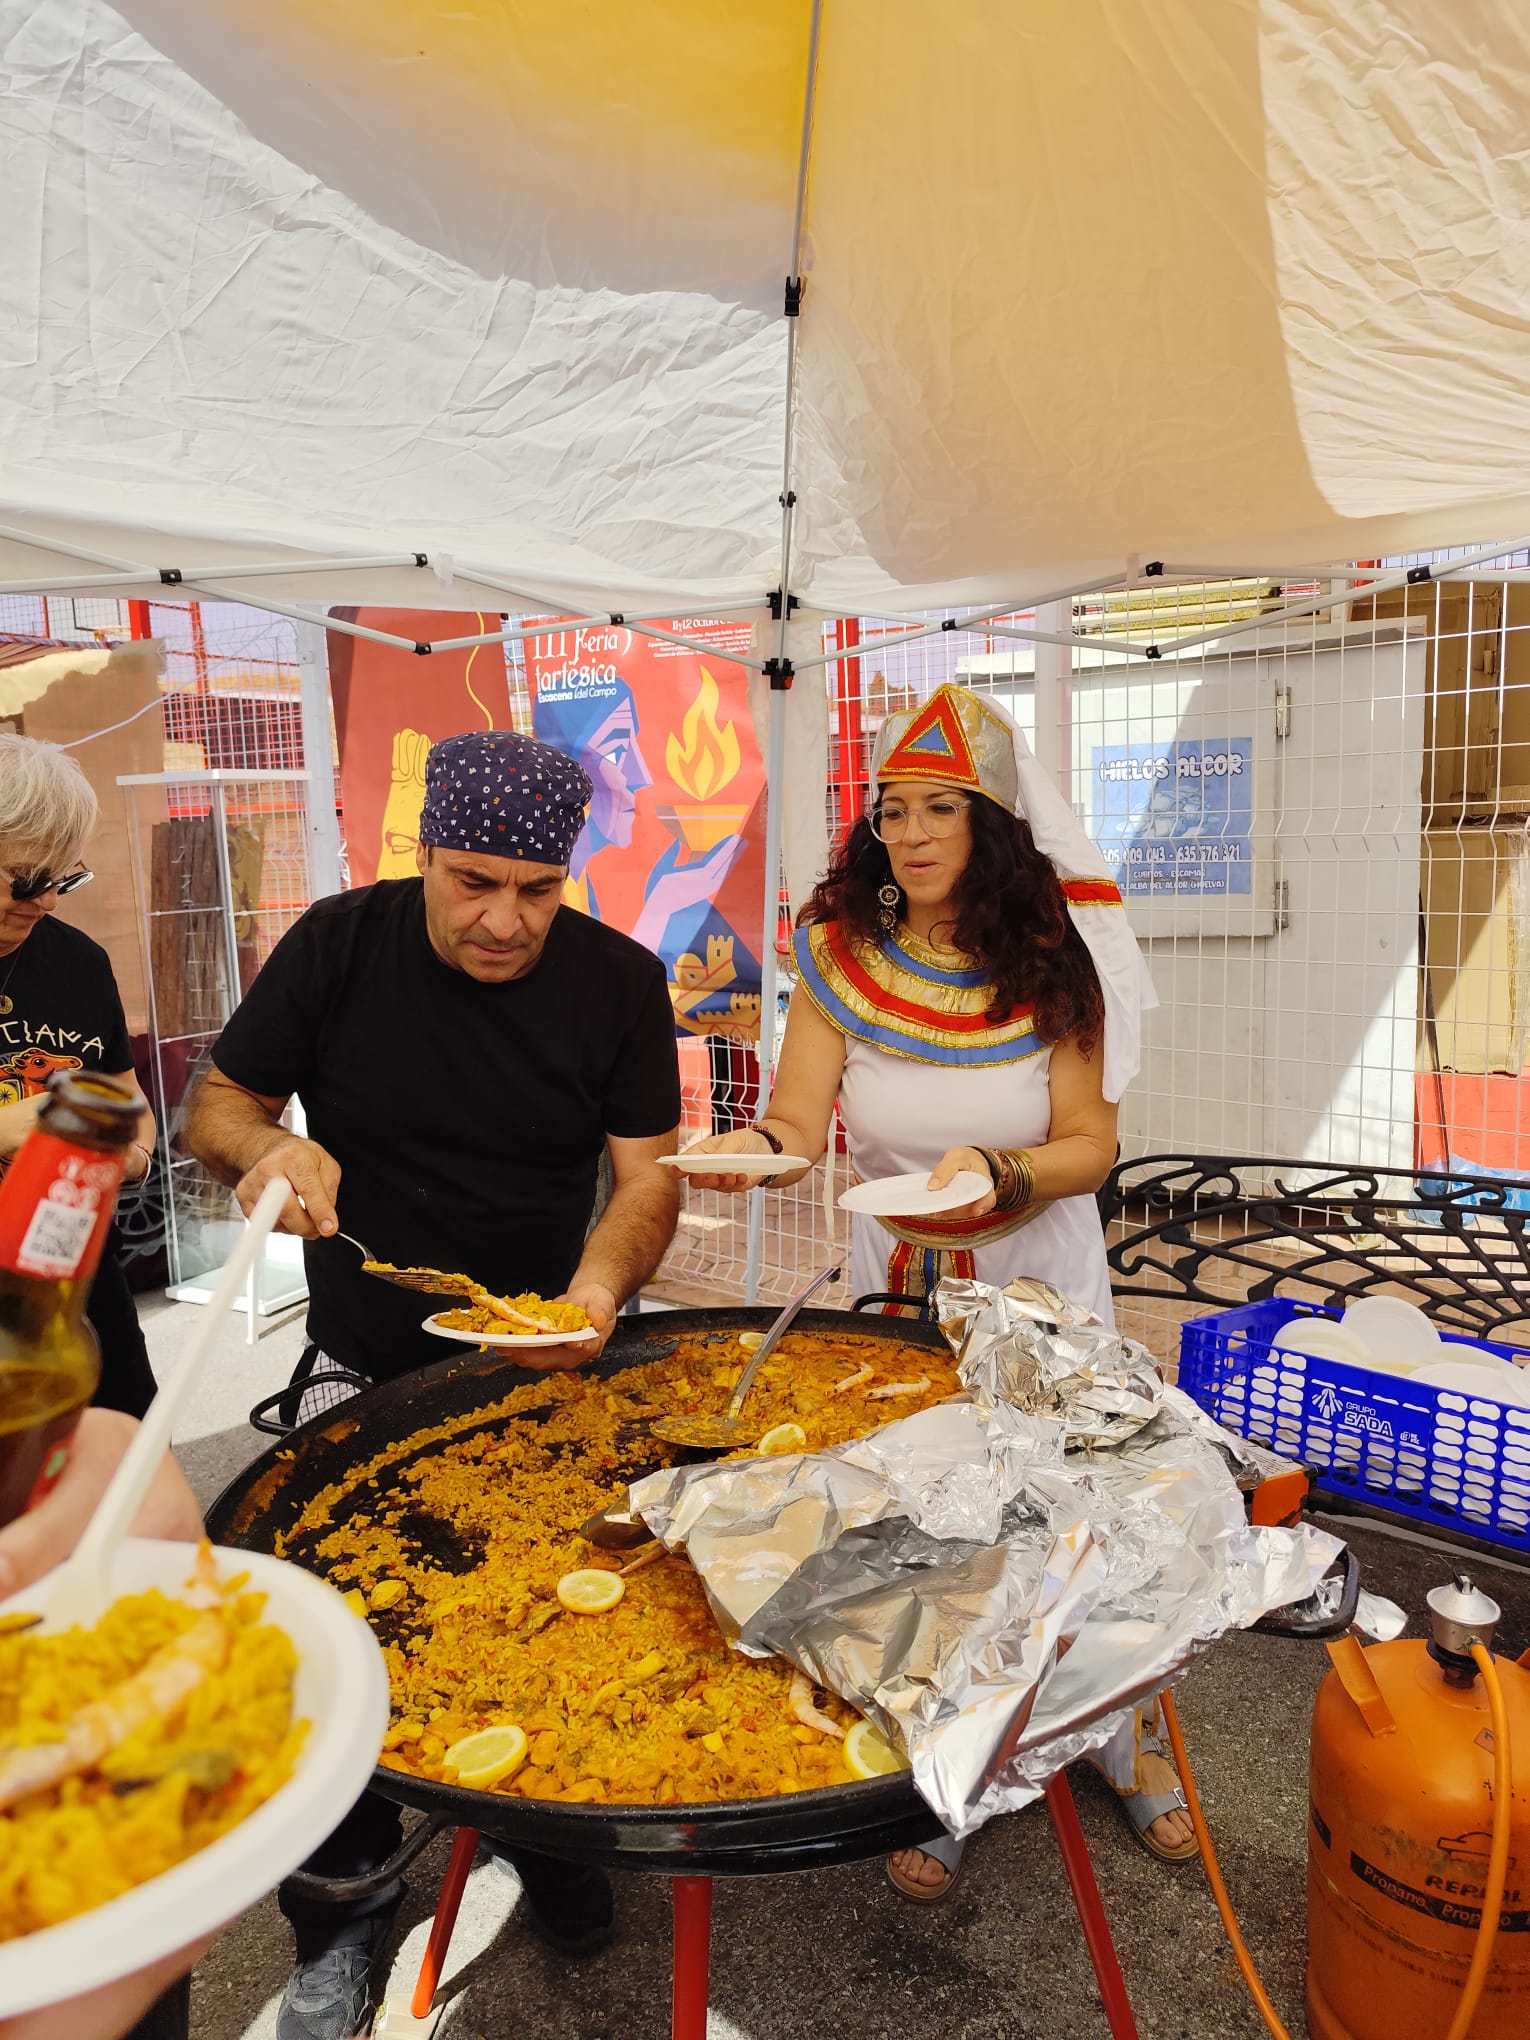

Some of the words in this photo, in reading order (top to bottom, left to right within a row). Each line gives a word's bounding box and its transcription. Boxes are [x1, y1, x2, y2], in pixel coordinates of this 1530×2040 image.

[569, 628, 618, 665] Feria
[538, 692, 573, 704] Escacena
[577, 688, 588, 698] del
[589, 687, 617, 699] Campo
[1100, 757, 1169, 782] HIELOS
[1175, 752, 1244, 778] ALCOR
[1177, 845, 1197, 863] 635
[1200, 844, 1219, 862] 576
[1222, 843, 1240, 862] 321
[1346, 1401, 1376, 1417] GRUPO
[1344, 1411, 1394, 1437] SADA
[1363, 1864, 1427, 1907] Propano
[1442, 1902, 1512, 1927] Propo
